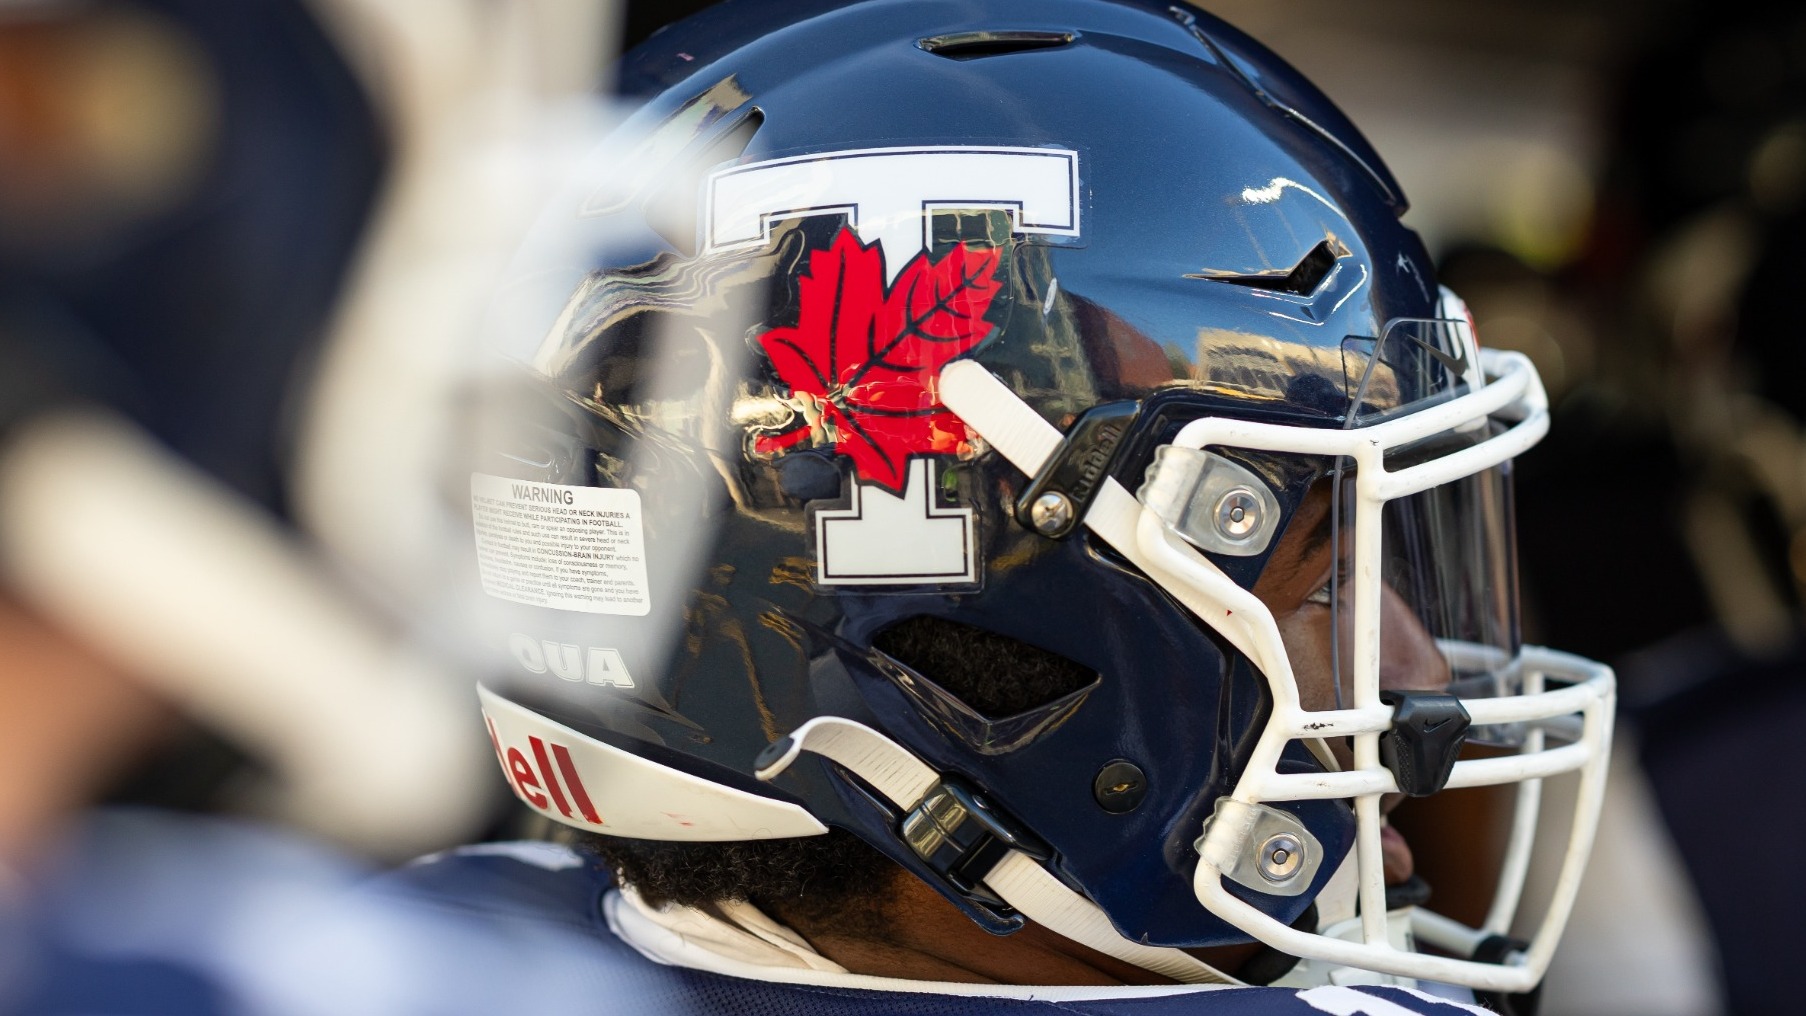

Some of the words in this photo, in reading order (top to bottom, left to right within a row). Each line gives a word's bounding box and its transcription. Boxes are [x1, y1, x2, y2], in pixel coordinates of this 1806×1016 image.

[705, 145, 1080, 585] T
[1069, 423, 1123, 503] Riddell
[506, 501, 527, 510] PREVENT
[529, 505, 551, 513] SERIOUS
[512, 484, 573, 505] WARNING
[503, 510, 523, 518] RECEIVE
[524, 513, 539, 521] WHILE
[540, 515, 580, 525] PARTICIPATING
[589, 520, 623, 528] FOOTBALL.
[537, 548, 591, 559] CONCUSSION-BRAIN
[509, 633, 635, 688] OUA
[487, 716, 603, 824] ell
